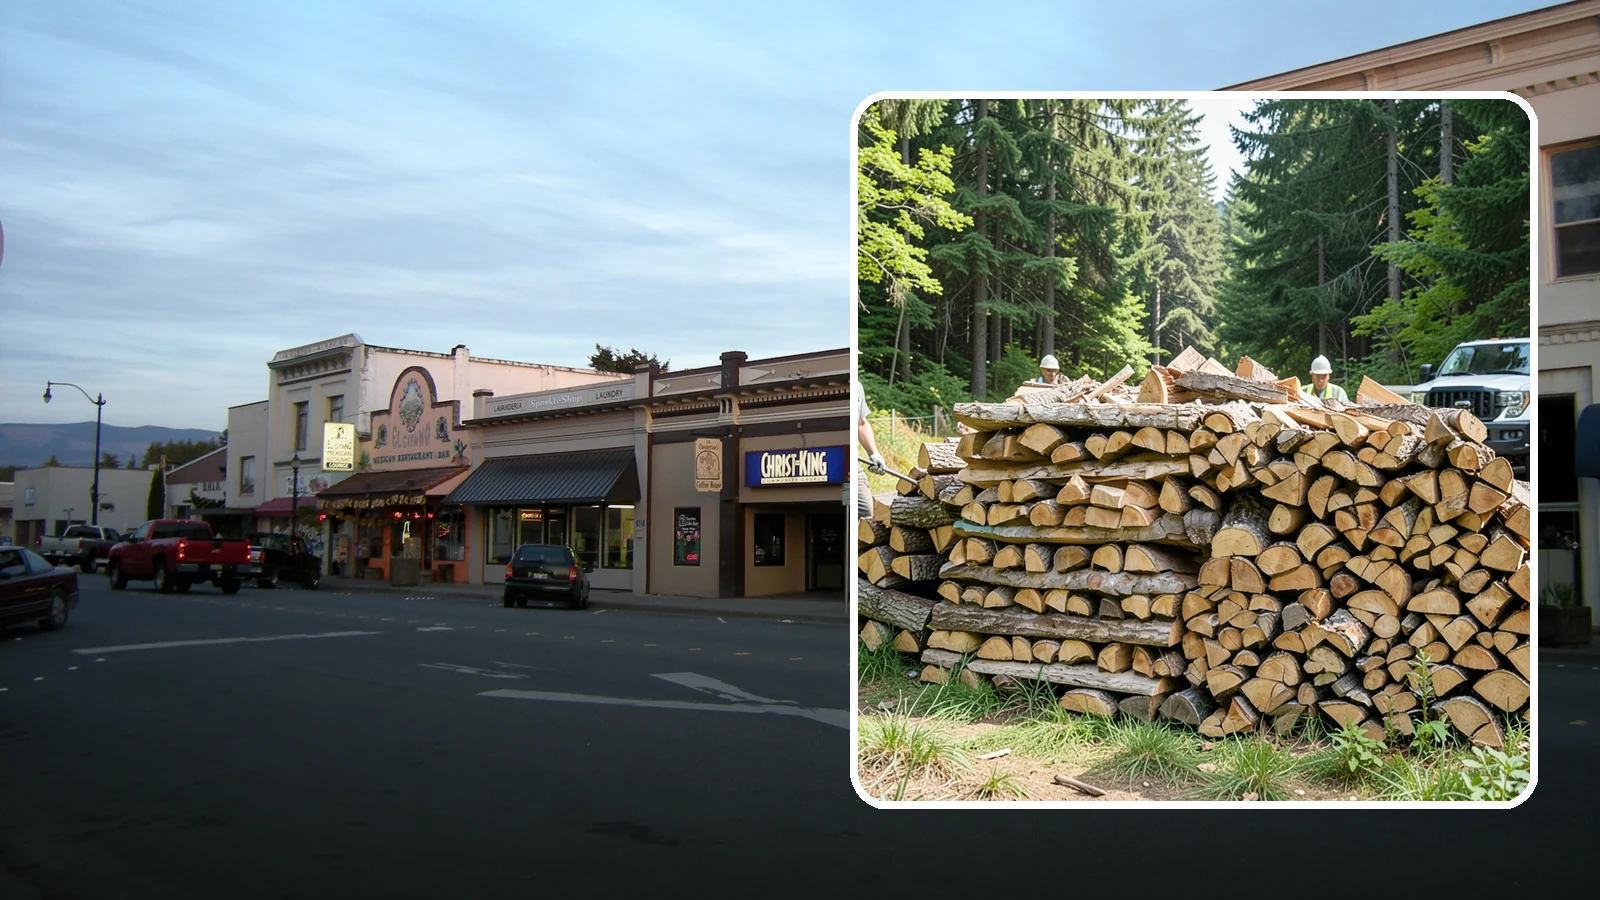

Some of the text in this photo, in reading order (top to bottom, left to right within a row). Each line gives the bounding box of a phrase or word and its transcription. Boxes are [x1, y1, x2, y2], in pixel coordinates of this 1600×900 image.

[531, 394, 583, 409] Sparkle Shop
[595, 389, 623, 400] LAUNDRY
[493, 402, 522, 413] LAVANDERIA
[392, 425, 401, 449] EL
[373, 455, 395, 464] MEXICAN
[397, 451, 434, 462] RESTAURANT
[438, 450, 450, 459] BAR
[760, 449, 828, 478] CHRIST KING
